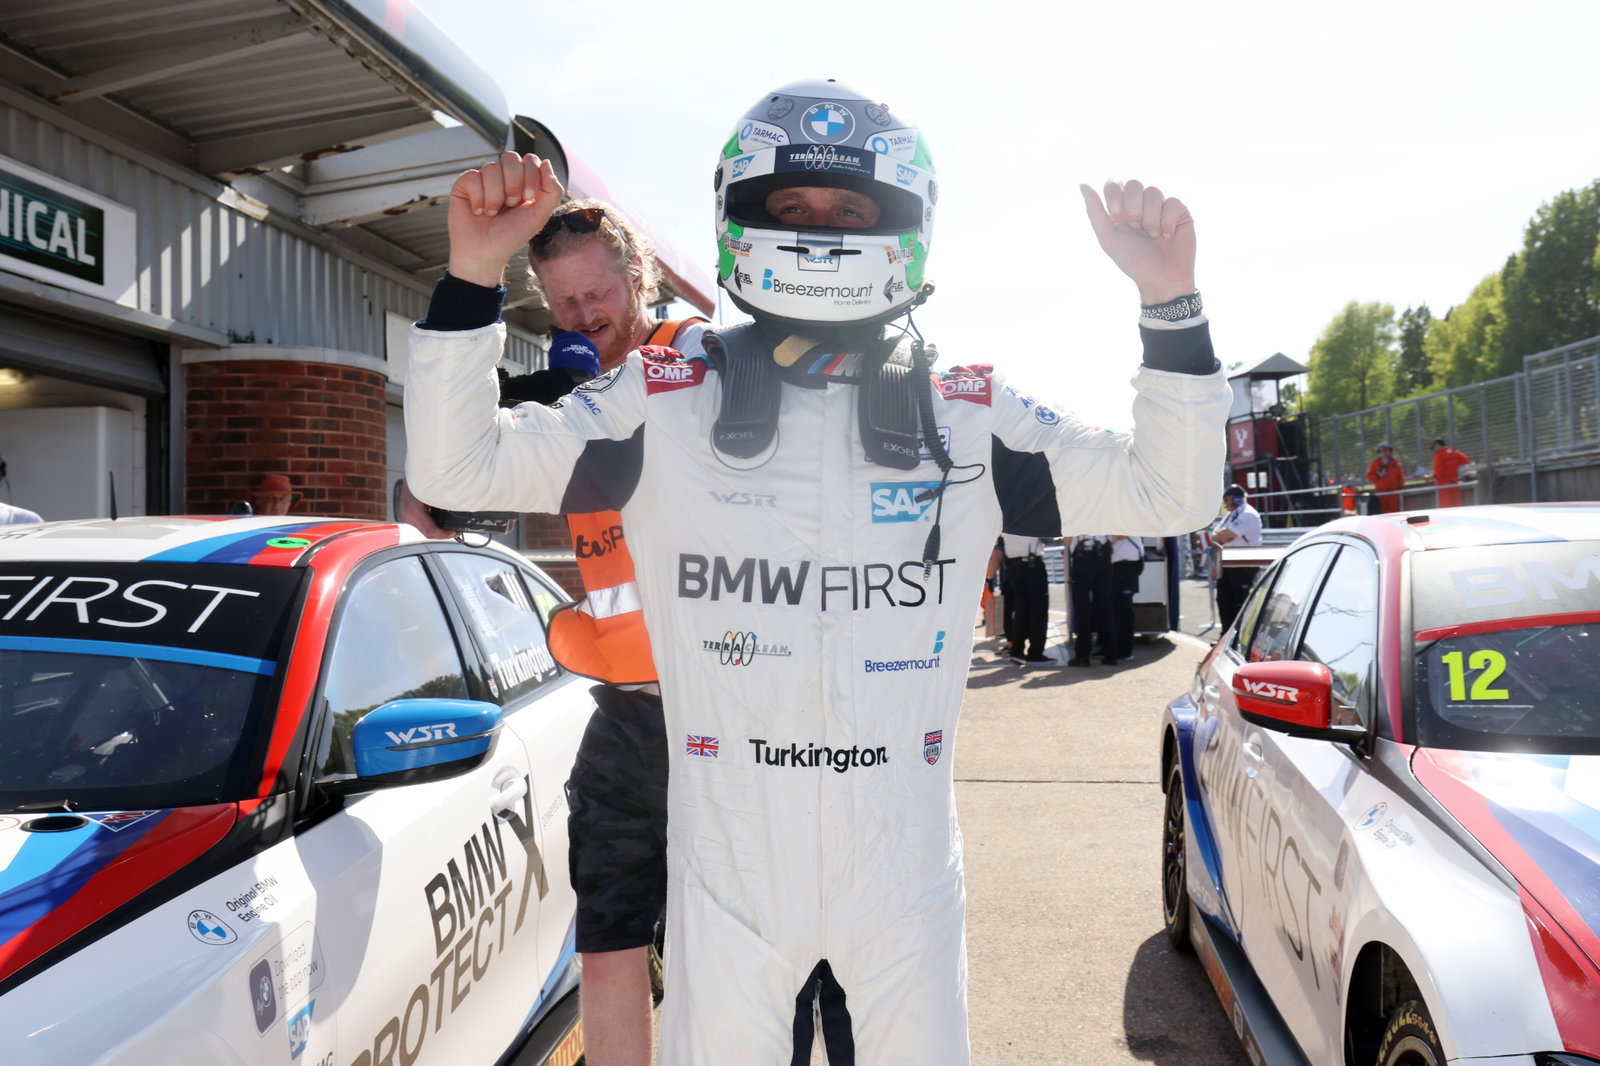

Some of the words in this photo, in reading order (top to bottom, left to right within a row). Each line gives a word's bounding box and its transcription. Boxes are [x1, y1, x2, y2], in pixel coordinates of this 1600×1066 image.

[809, 103, 849, 117] BMW
[753, 127, 784, 143] TARMAC
[733, 158, 749, 176] SAP
[789, 152, 860, 164] TERRACLEAN
[773, 278, 873, 298] Breezemount
[647, 366, 694, 380] OMP
[942, 380, 986, 393] OMP
[708, 490, 777, 508] WSR
[678, 553, 811, 605] BMW
[821, 558, 956, 612] FIRST
[864, 656, 940, 673] Breezemount
[1441, 649, 1510, 702] 12
[1241, 677, 1299, 703] WSR
[385, 722, 458, 744] WSR
[749, 738, 889, 773] Turkington
[225, 884, 258, 913] Original
[255, 875, 279, 893] BMW
[424, 808, 507, 959] BMW
[237, 902, 266, 923] Engine
[264, 893, 278, 911] Oil
[350, 879, 513, 1066] ROTECT
[289, 1012, 311, 1053] SAP
